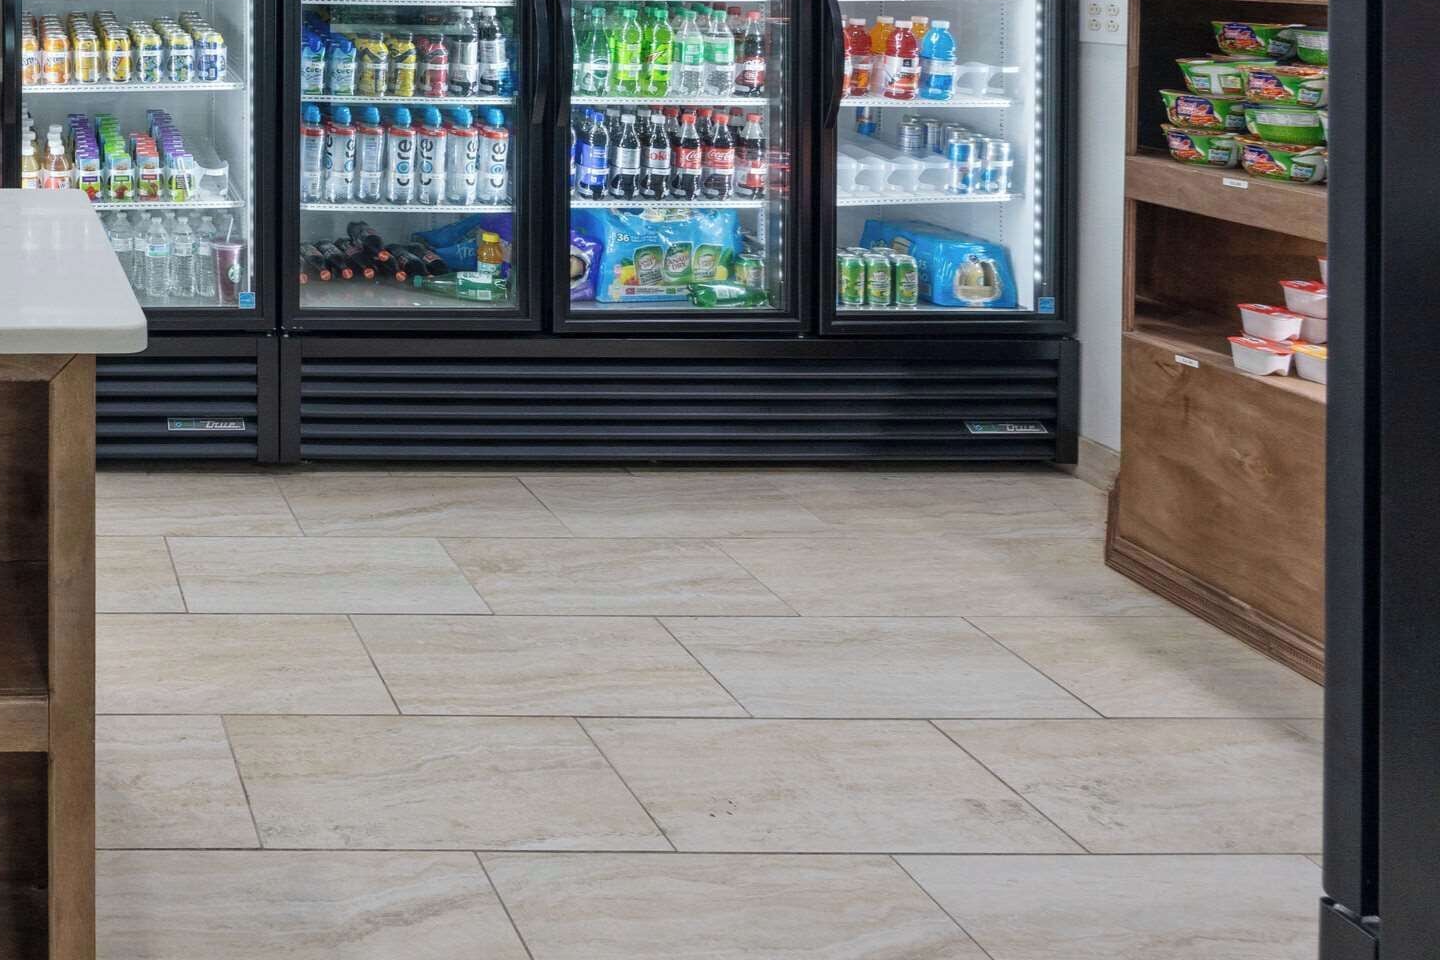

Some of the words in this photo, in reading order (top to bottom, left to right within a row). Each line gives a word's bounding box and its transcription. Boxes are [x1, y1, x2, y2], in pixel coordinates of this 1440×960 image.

[396, 139, 413, 187] core
[419, 138, 434, 186] core
[465, 139, 478, 186] core
[490, 141, 507, 188] core
[615, 233, 630, 242] 36
